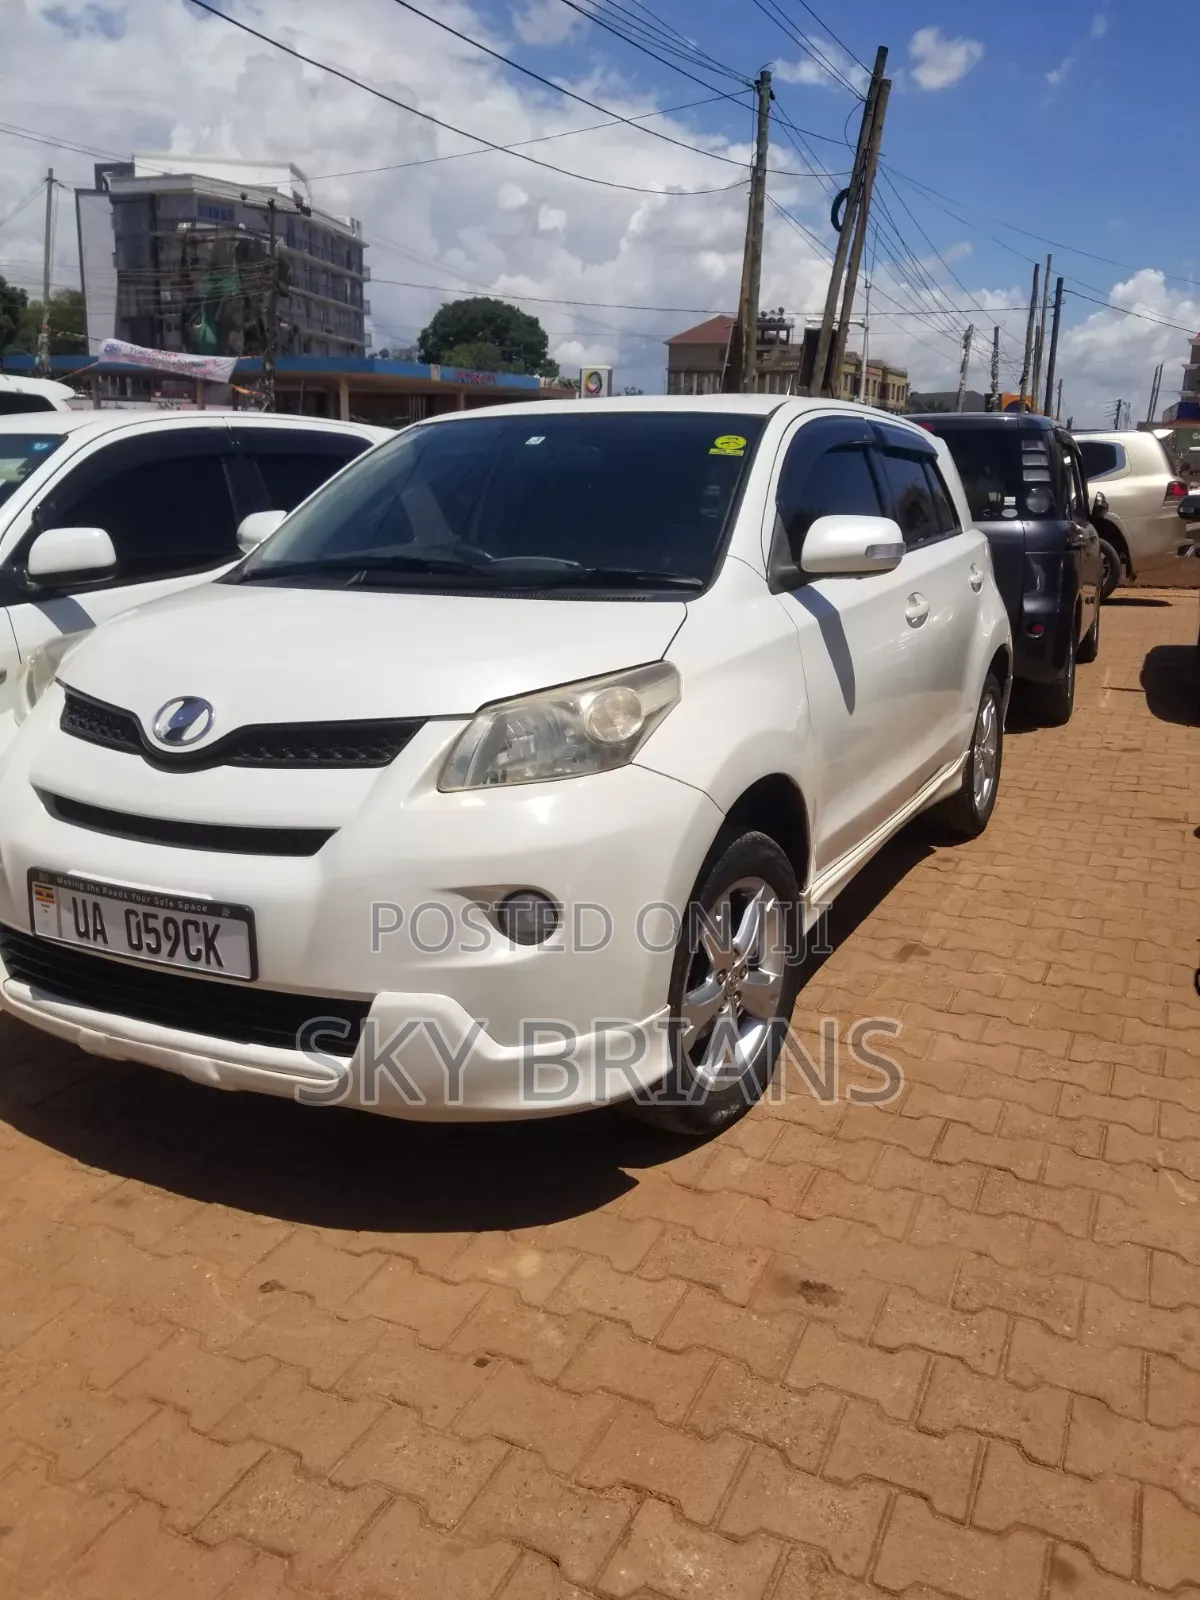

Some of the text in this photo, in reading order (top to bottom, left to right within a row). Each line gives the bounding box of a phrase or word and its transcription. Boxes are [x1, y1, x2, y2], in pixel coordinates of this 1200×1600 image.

[102, 886, 128, 899] Roads
[131, 892, 150, 903] Your
[154, 896, 174, 907] Safe
[178, 901, 208, 912] Space
[71, 896, 225, 968] UA 059CK
